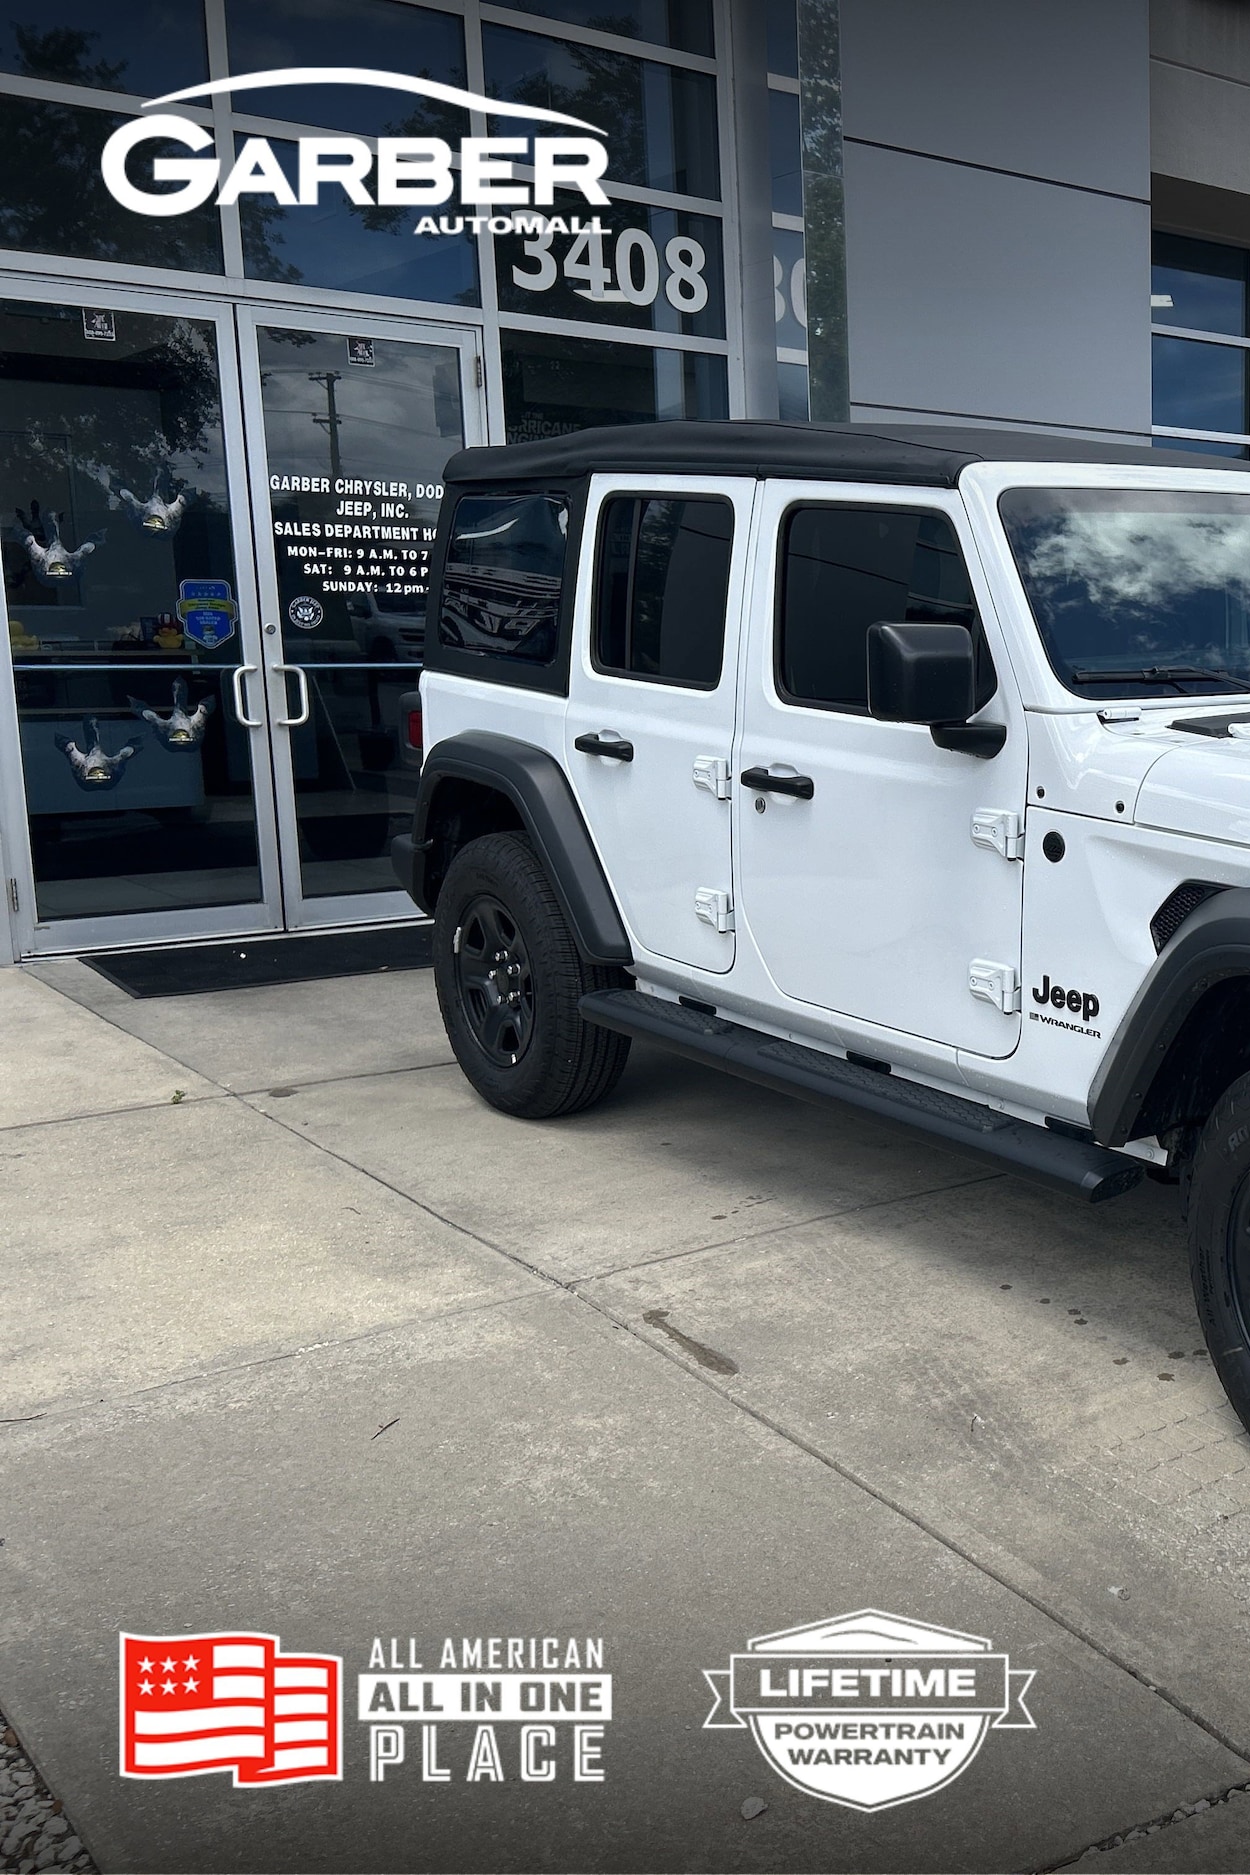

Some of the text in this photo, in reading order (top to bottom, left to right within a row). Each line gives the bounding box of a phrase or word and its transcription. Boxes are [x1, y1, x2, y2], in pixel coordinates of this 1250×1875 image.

[511, 209, 709, 313] 3408
[269, 474, 330, 493] GARBER
[335, 478, 412, 501] CHRYSLER,
[336, 501, 409, 520] JEEP, INC.
[274, 521, 321, 537] SALES
[324, 523, 418, 541] DEPARTMENT
[356, 548, 365, 559] 9
[369, 549, 398, 560] A.M.
[401, 550, 417, 561] TO
[421, 550, 429, 561] 7
[303, 563, 333, 575] SAT:
[343, 564, 352, 575] 9
[356, 565, 385, 576] A.M.
[389, 565, 405, 577] TO
[409, 566, 417, 577] 6
[322, 581, 378, 593] SUNDAY:
[1032, 975, 1100, 1022] Jeep
[1039, 1014, 1102, 1039] WRANGLER
